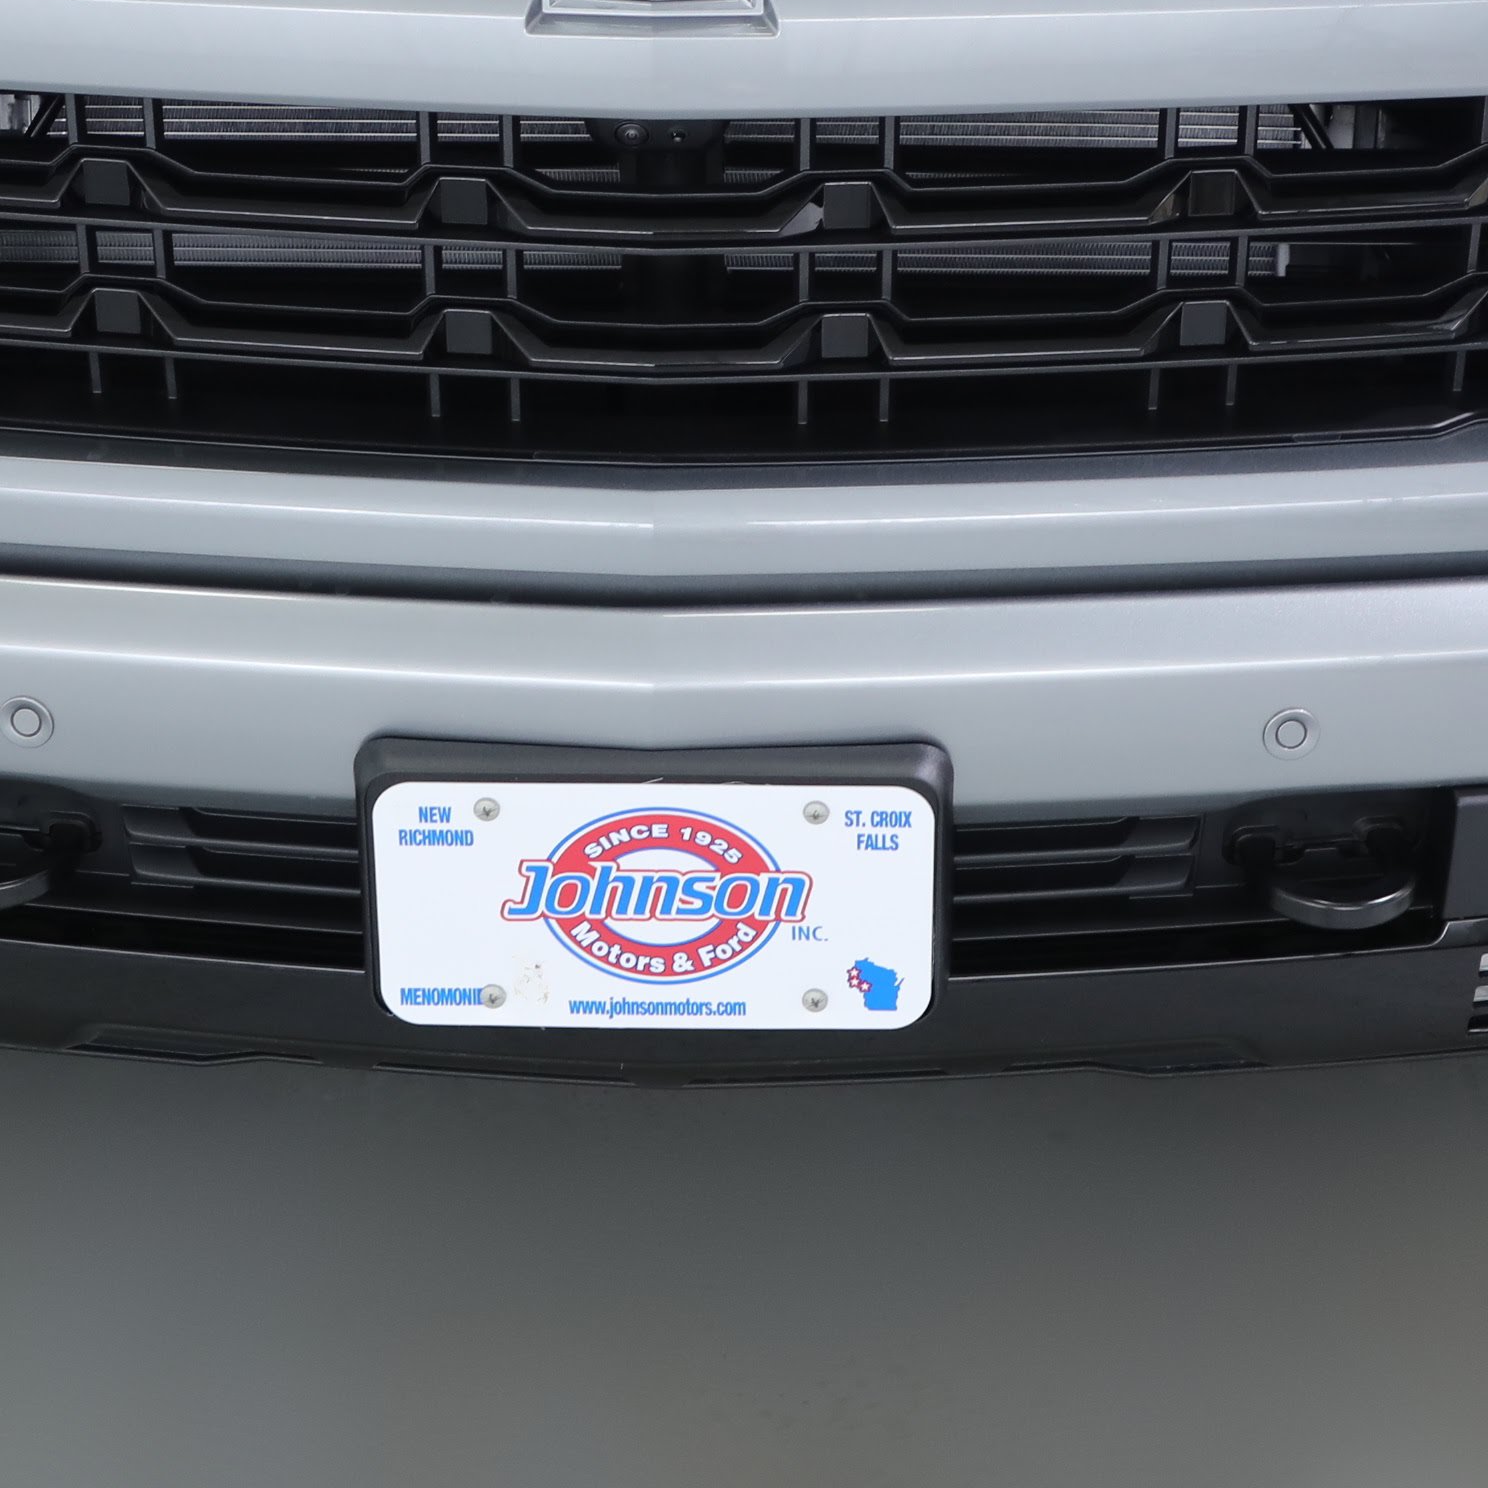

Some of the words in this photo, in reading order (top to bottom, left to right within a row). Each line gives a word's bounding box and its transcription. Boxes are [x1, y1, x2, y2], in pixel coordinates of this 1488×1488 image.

[418, 806, 452, 823] NEW
[844, 810, 865, 828] ST.
[871, 811, 912, 828] CROIX
[398, 829, 474, 846] RICHMOND
[583, 823, 669, 859] SINCE
[679, 826, 743, 864] 1925
[856, 833, 899, 851] FALLS
[504, 861, 811, 920] Johnson
[791, 926, 829, 942] INC.
[569, 919, 666, 974] Motors
[672, 951, 695, 973] &
[696, 922, 758, 968] Ford
[569, 997, 747, 1019] www.johnsonmotors.com
